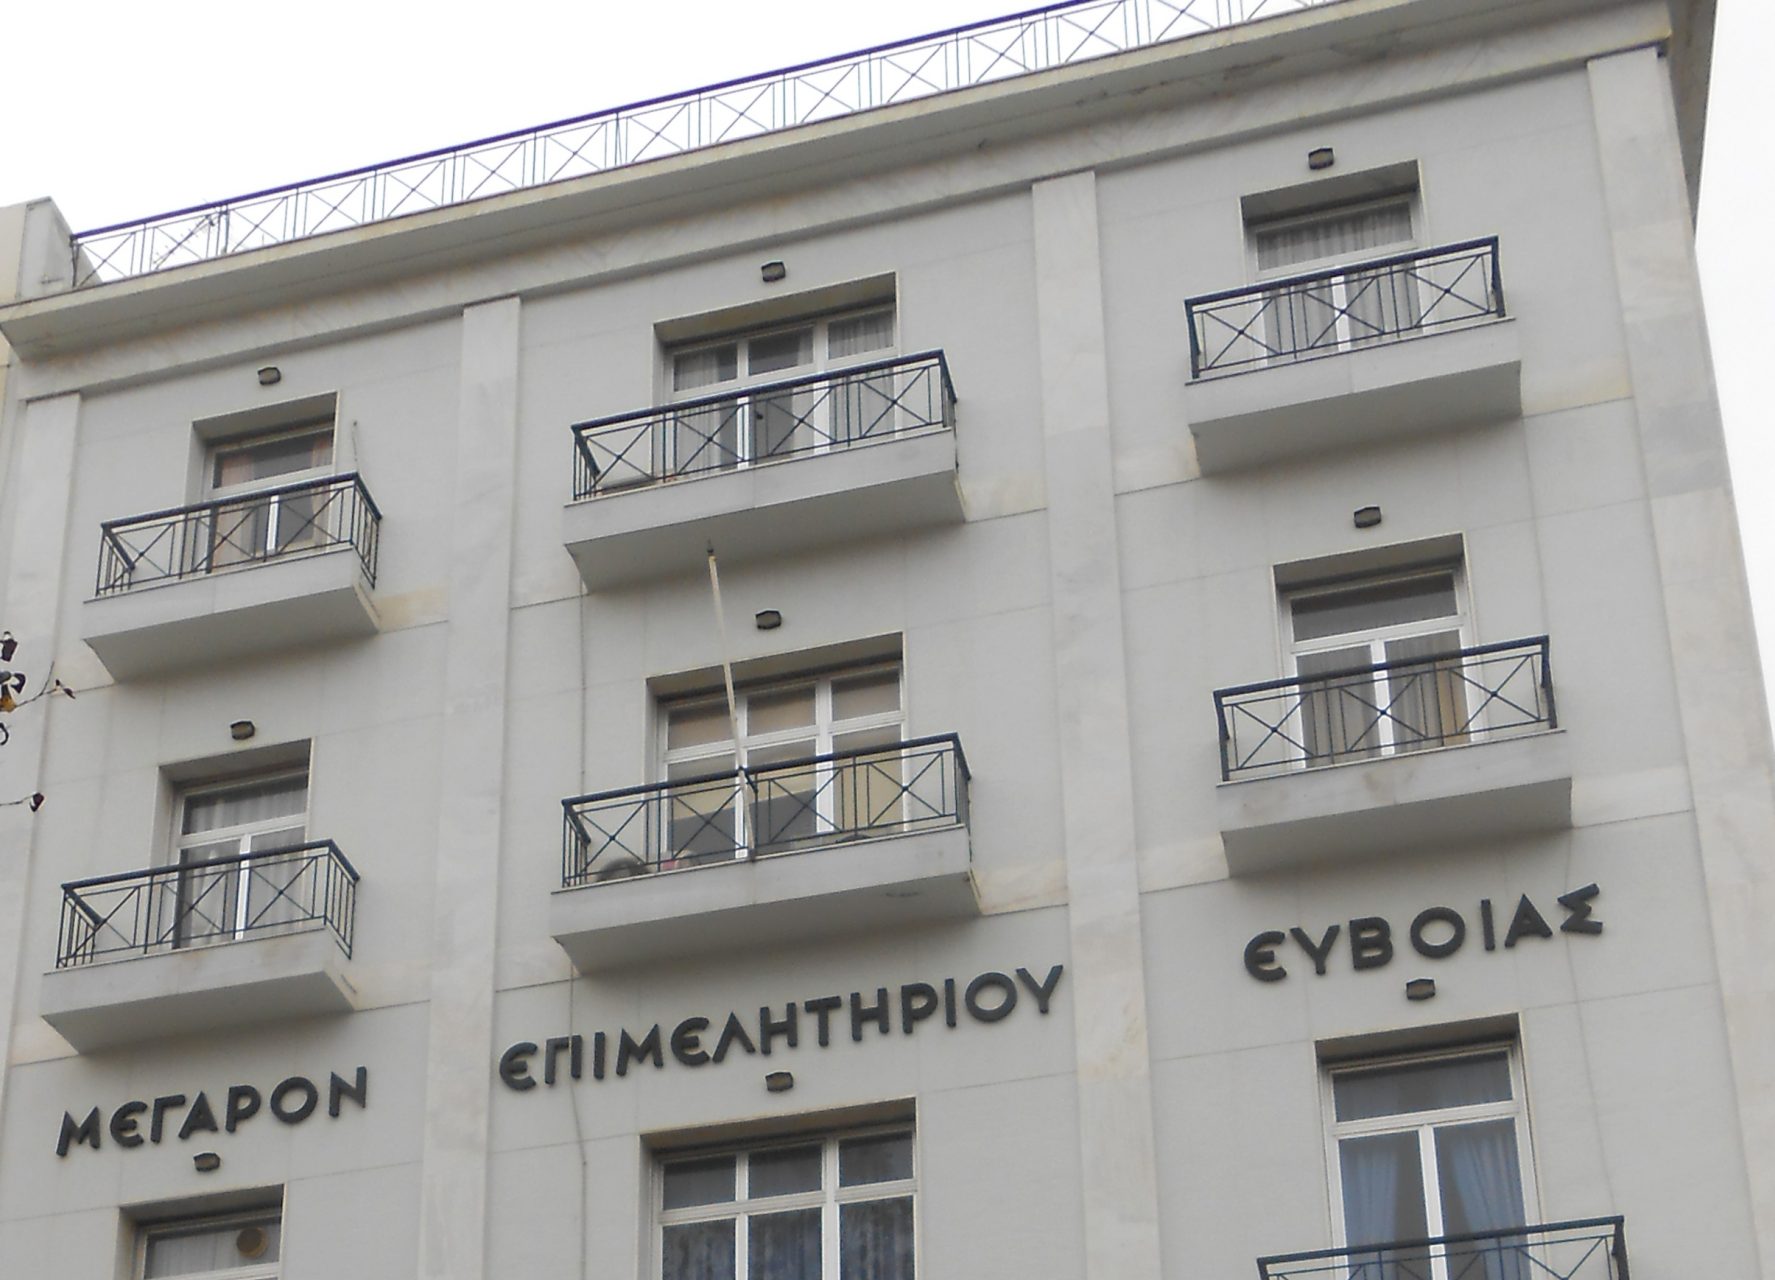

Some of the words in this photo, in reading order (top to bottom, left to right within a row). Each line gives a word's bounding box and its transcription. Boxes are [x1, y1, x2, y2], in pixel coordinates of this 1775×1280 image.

[55, 1065, 369, 1159] ΜΕΓΑΡΟΝ
[498, 964, 1064, 1093] ΕΠΙΜΕΛΗΤΗΡΙΟΥ
[1243, 883, 1604, 984] ΕΥΒΟΙΑΣ
